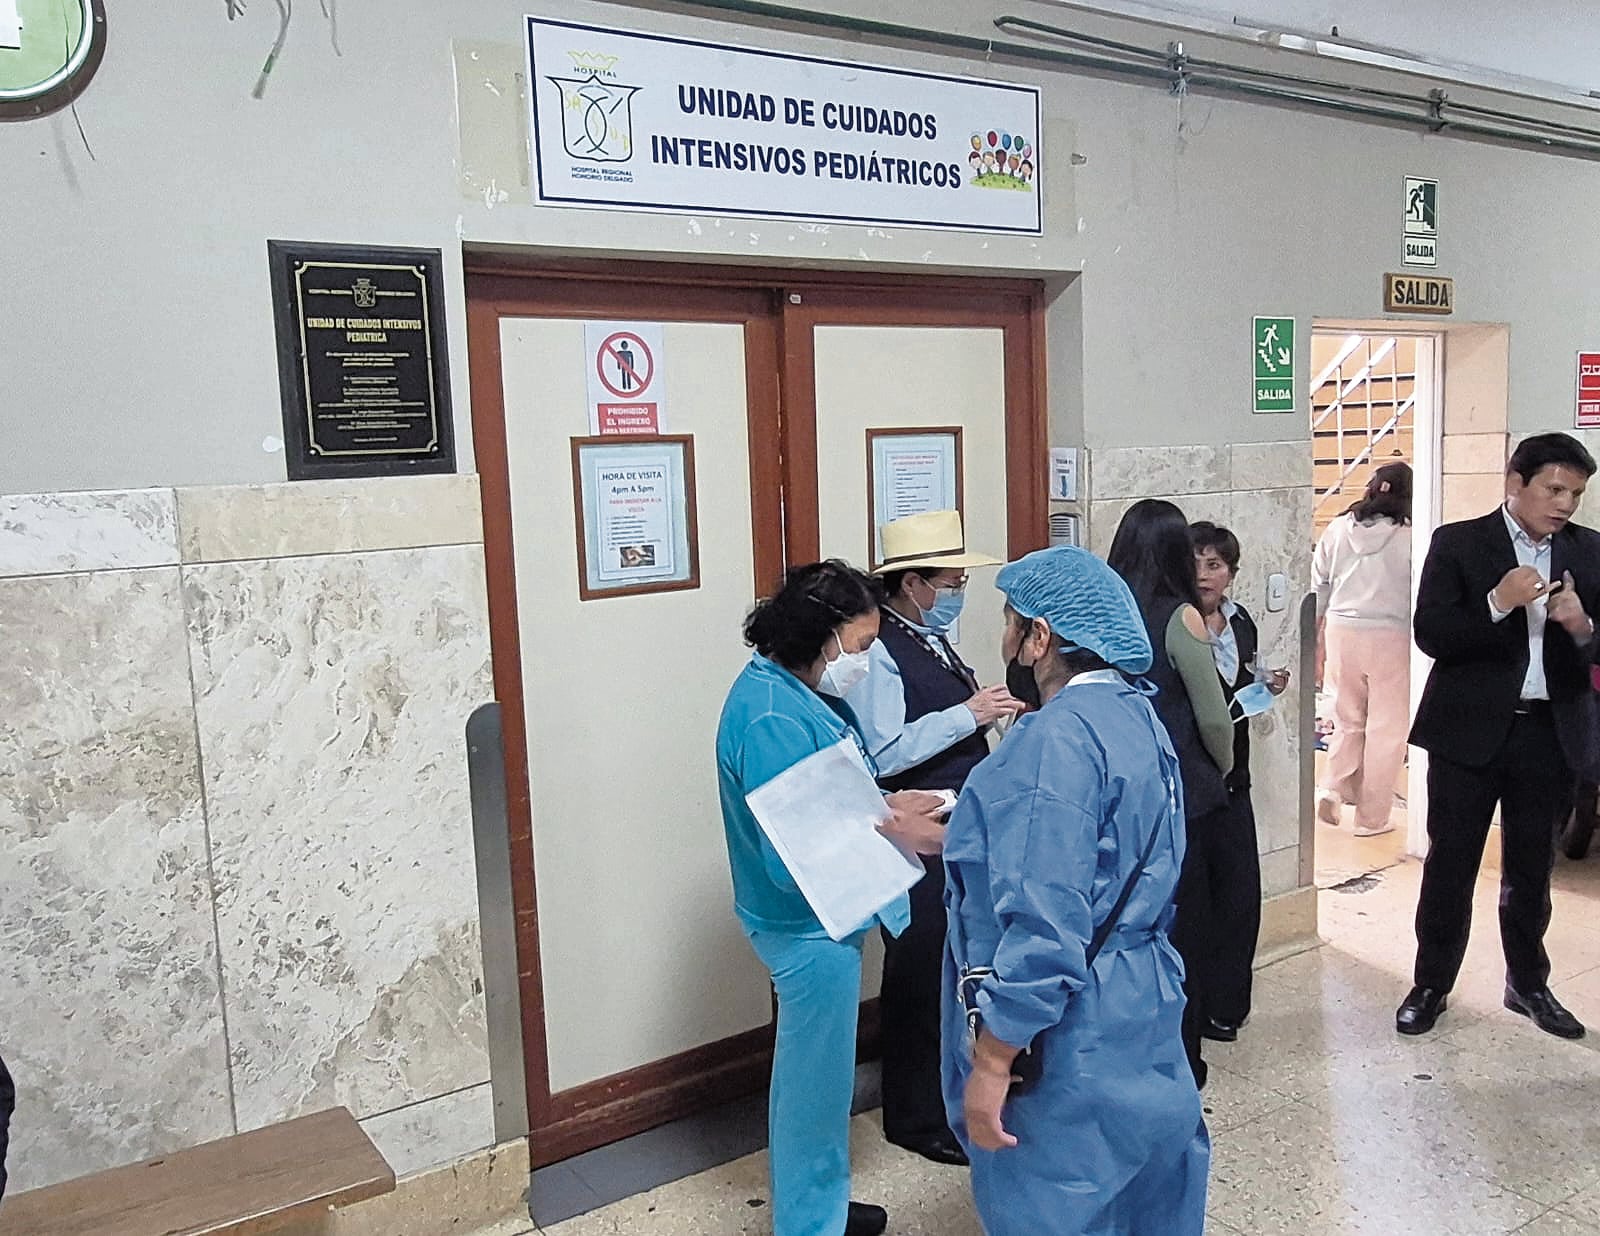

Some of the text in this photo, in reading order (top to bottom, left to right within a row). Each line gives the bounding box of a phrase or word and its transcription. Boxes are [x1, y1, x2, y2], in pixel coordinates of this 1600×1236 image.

[573, 66, 617, 78] HOSPITAL
[678, 85, 937, 140] UNIDAD DE CUIDADOS
[651, 135, 962, 189] INTENSIVOS PEDIÁTRICOS
[571, 166, 632, 177] HOSPITAL REGIONAL
[1406, 243, 1434, 258] SALIDA
[1394, 280, 1448, 307] SALIDA
[307, 317, 422, 330] UNIDAD DE CUIDADOS INTENSIVOS
[1257, 389, 1291, 401] SALIDA
[607, 407, 649, 416] PROHIBIDO
[606, 417, 651, 426] EL INGRESO
[602, 471, 662, 481] HORA DE VISITA
[611, 484, 655, 496] 4pm A 5pm
